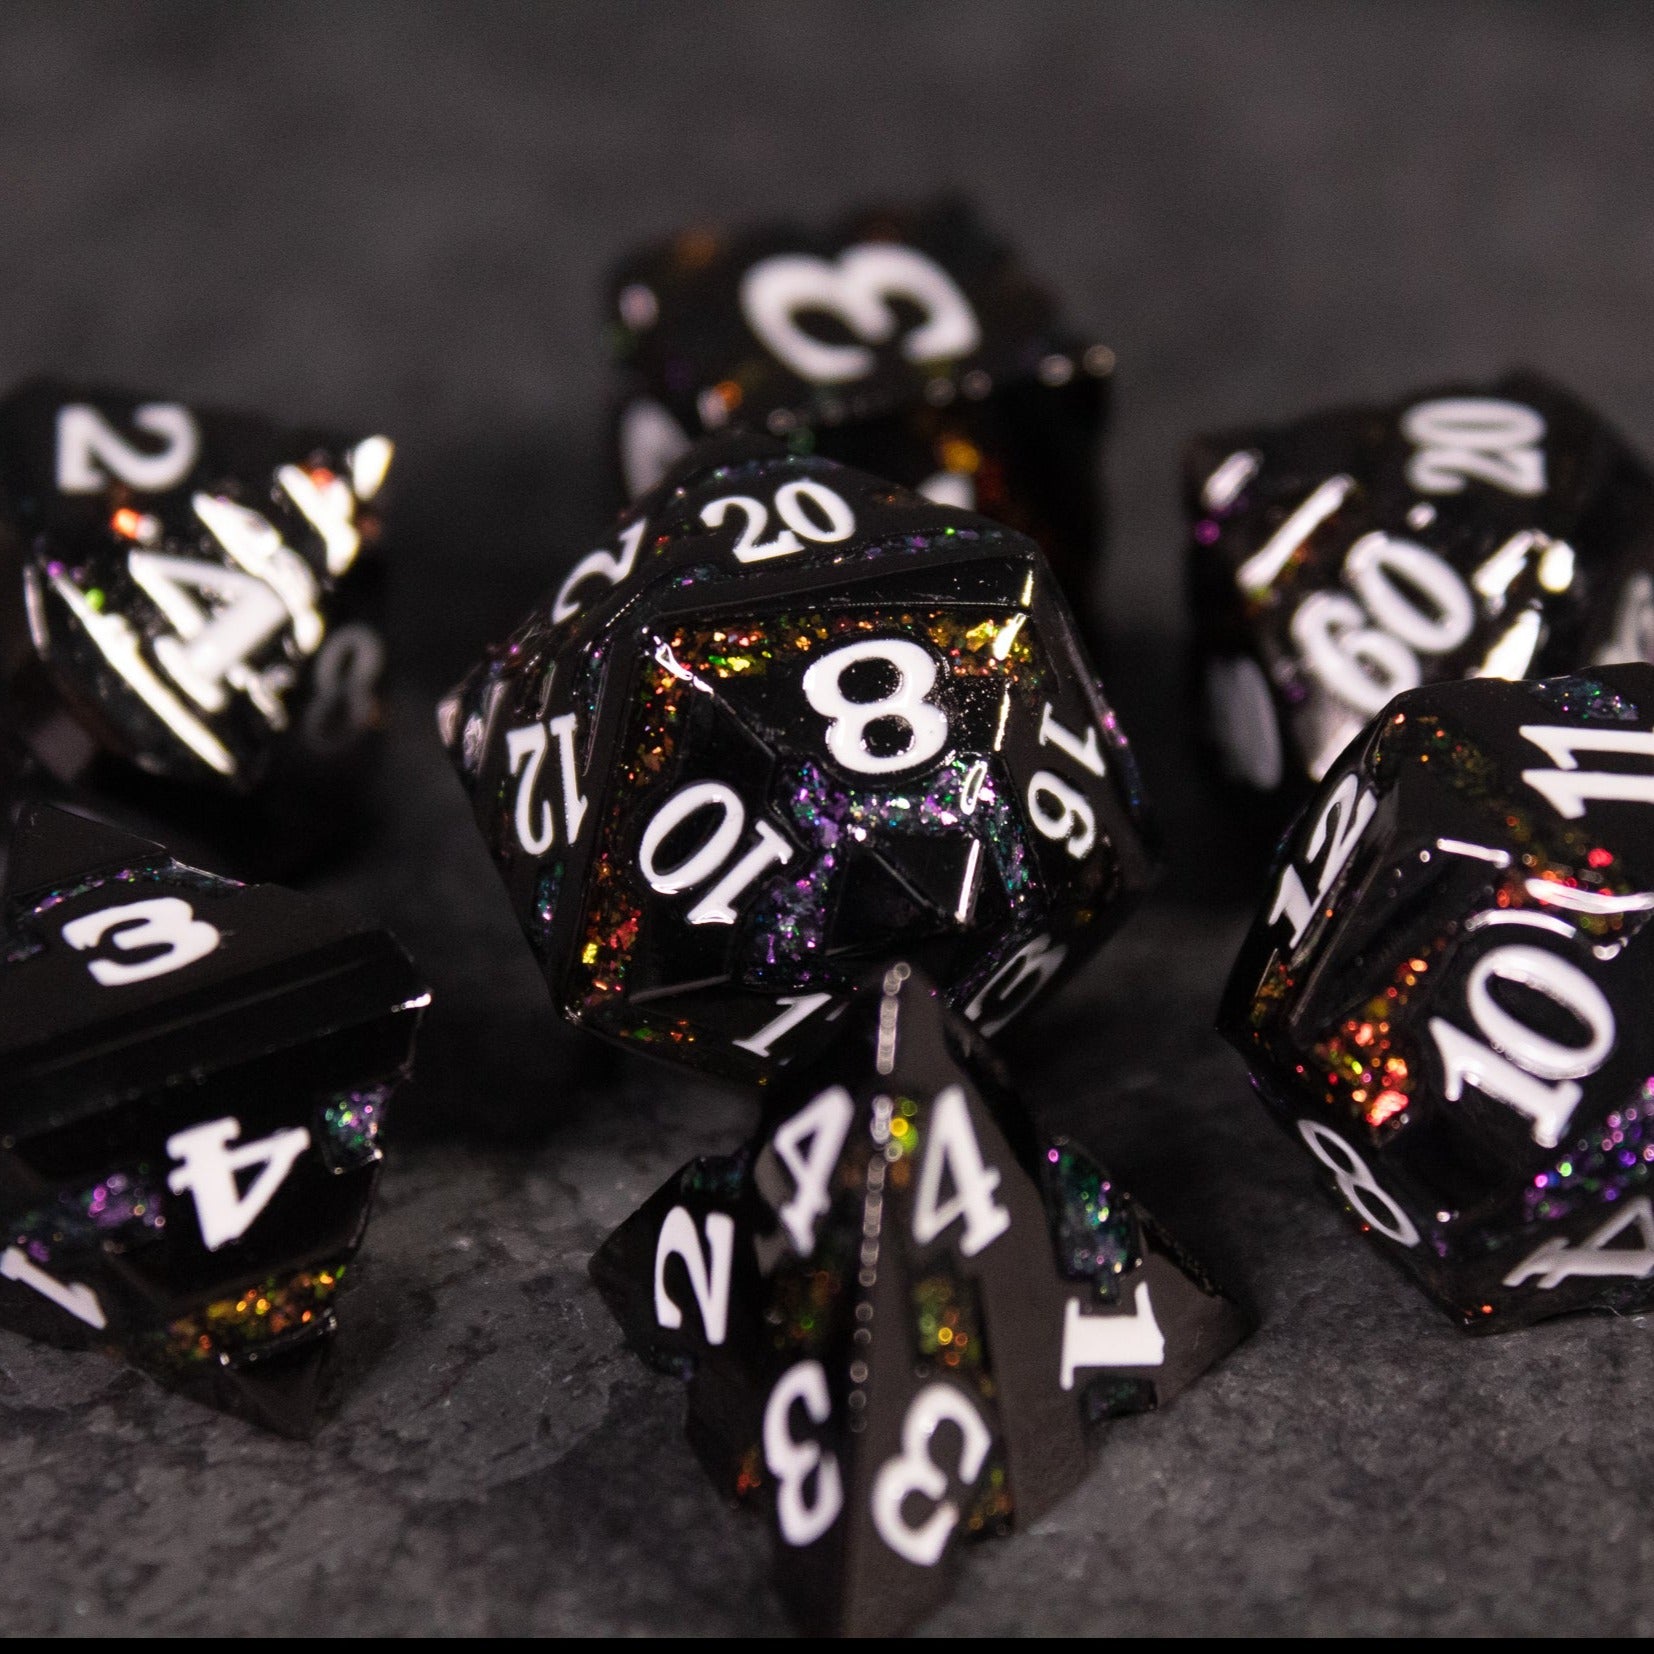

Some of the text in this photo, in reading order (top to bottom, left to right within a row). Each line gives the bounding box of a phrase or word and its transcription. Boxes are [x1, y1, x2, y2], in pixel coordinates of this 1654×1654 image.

[743, 244, 978, 382] 3
[56, 404, 197, 493] 2
[1405, 398, 1547, 496] 20
[552, 518, 646, 625] 2
[700, 479, 855, 564] 20
[1293, 531, 1474, 719] 60
[802, 638, 948, 775] 8
[1519, 725, 1654, 819] 11
[506, 712, 588, 855] 12
[1028, 701, 1105, 859] 16
[638, 782, 794, 925] 10
[1268, 773, 1377, 949] 12
[62, 897, 220, 986] 3
[964, 933, 1068, 1038] 3
[1429, 944, 1616, 1149] 10
[167, 1116, 310, 1250] 4
[774, 1086, 853, 1254] 4
[913, 1086, 1010, 1256] 4
[1298, 1120, 1420, 1247] 8
[0, 1246, 106, 1329] 1
[655, 1206, 734, 1344] 2
[1502, 1197, 1654, 1289] 4
[1059, 1281, 1165, 1390] 1
[764, 1361, 843, 1547] 3
[872, 1384, 991, 1566] 3
